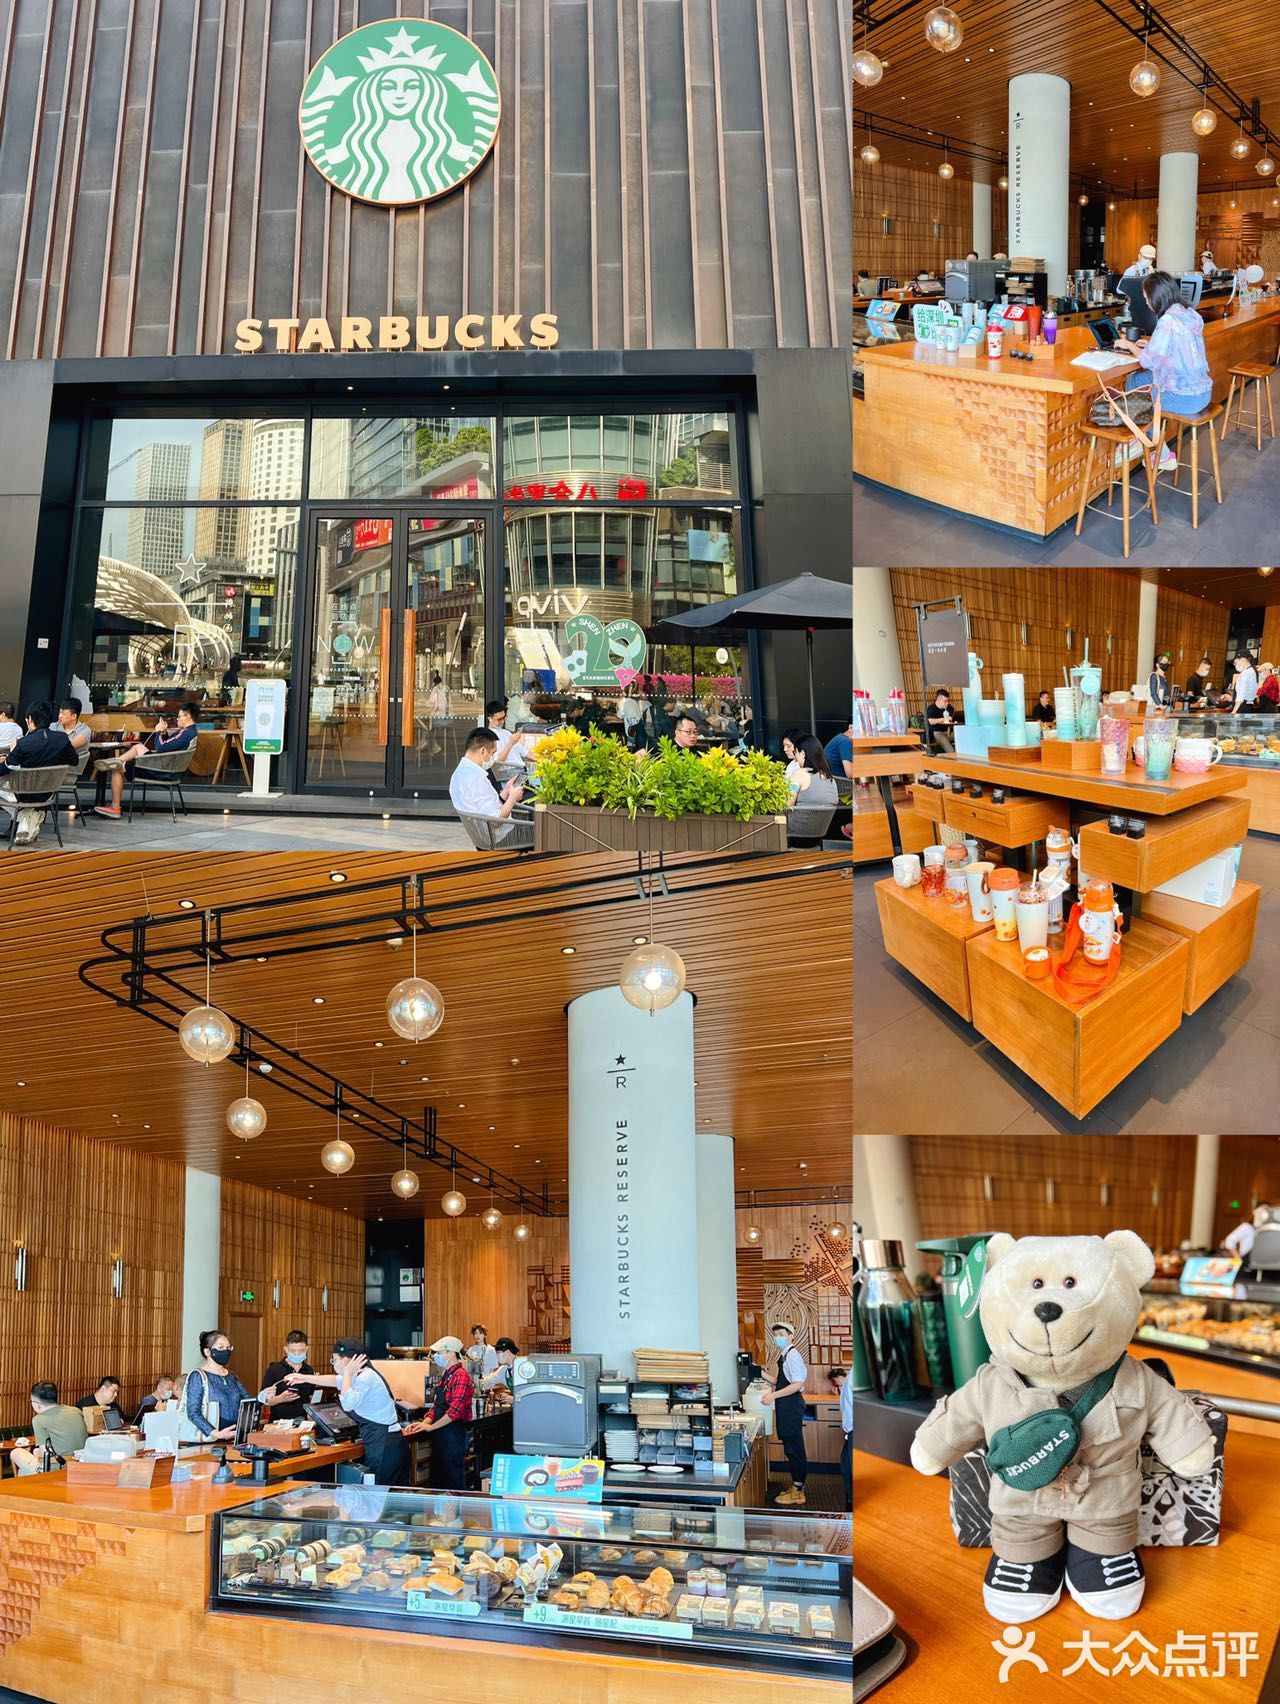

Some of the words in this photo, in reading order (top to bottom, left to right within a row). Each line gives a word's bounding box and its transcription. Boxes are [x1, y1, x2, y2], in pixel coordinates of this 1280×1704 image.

[235, 313, 560, 352] STARBUCKS
[578, 617, 601, 637] SHEN
[605, 621, 629, 637] ZHEN
[615, 1075, 627, 1089] R
[616, 1119, 629, 1202] RESERVE
[617, 1213, 631, 1320] STARBUCKS
[1005, 1428, 1071, 1478] STARBUCKS
[533, 1605, 547, 1623] +9
